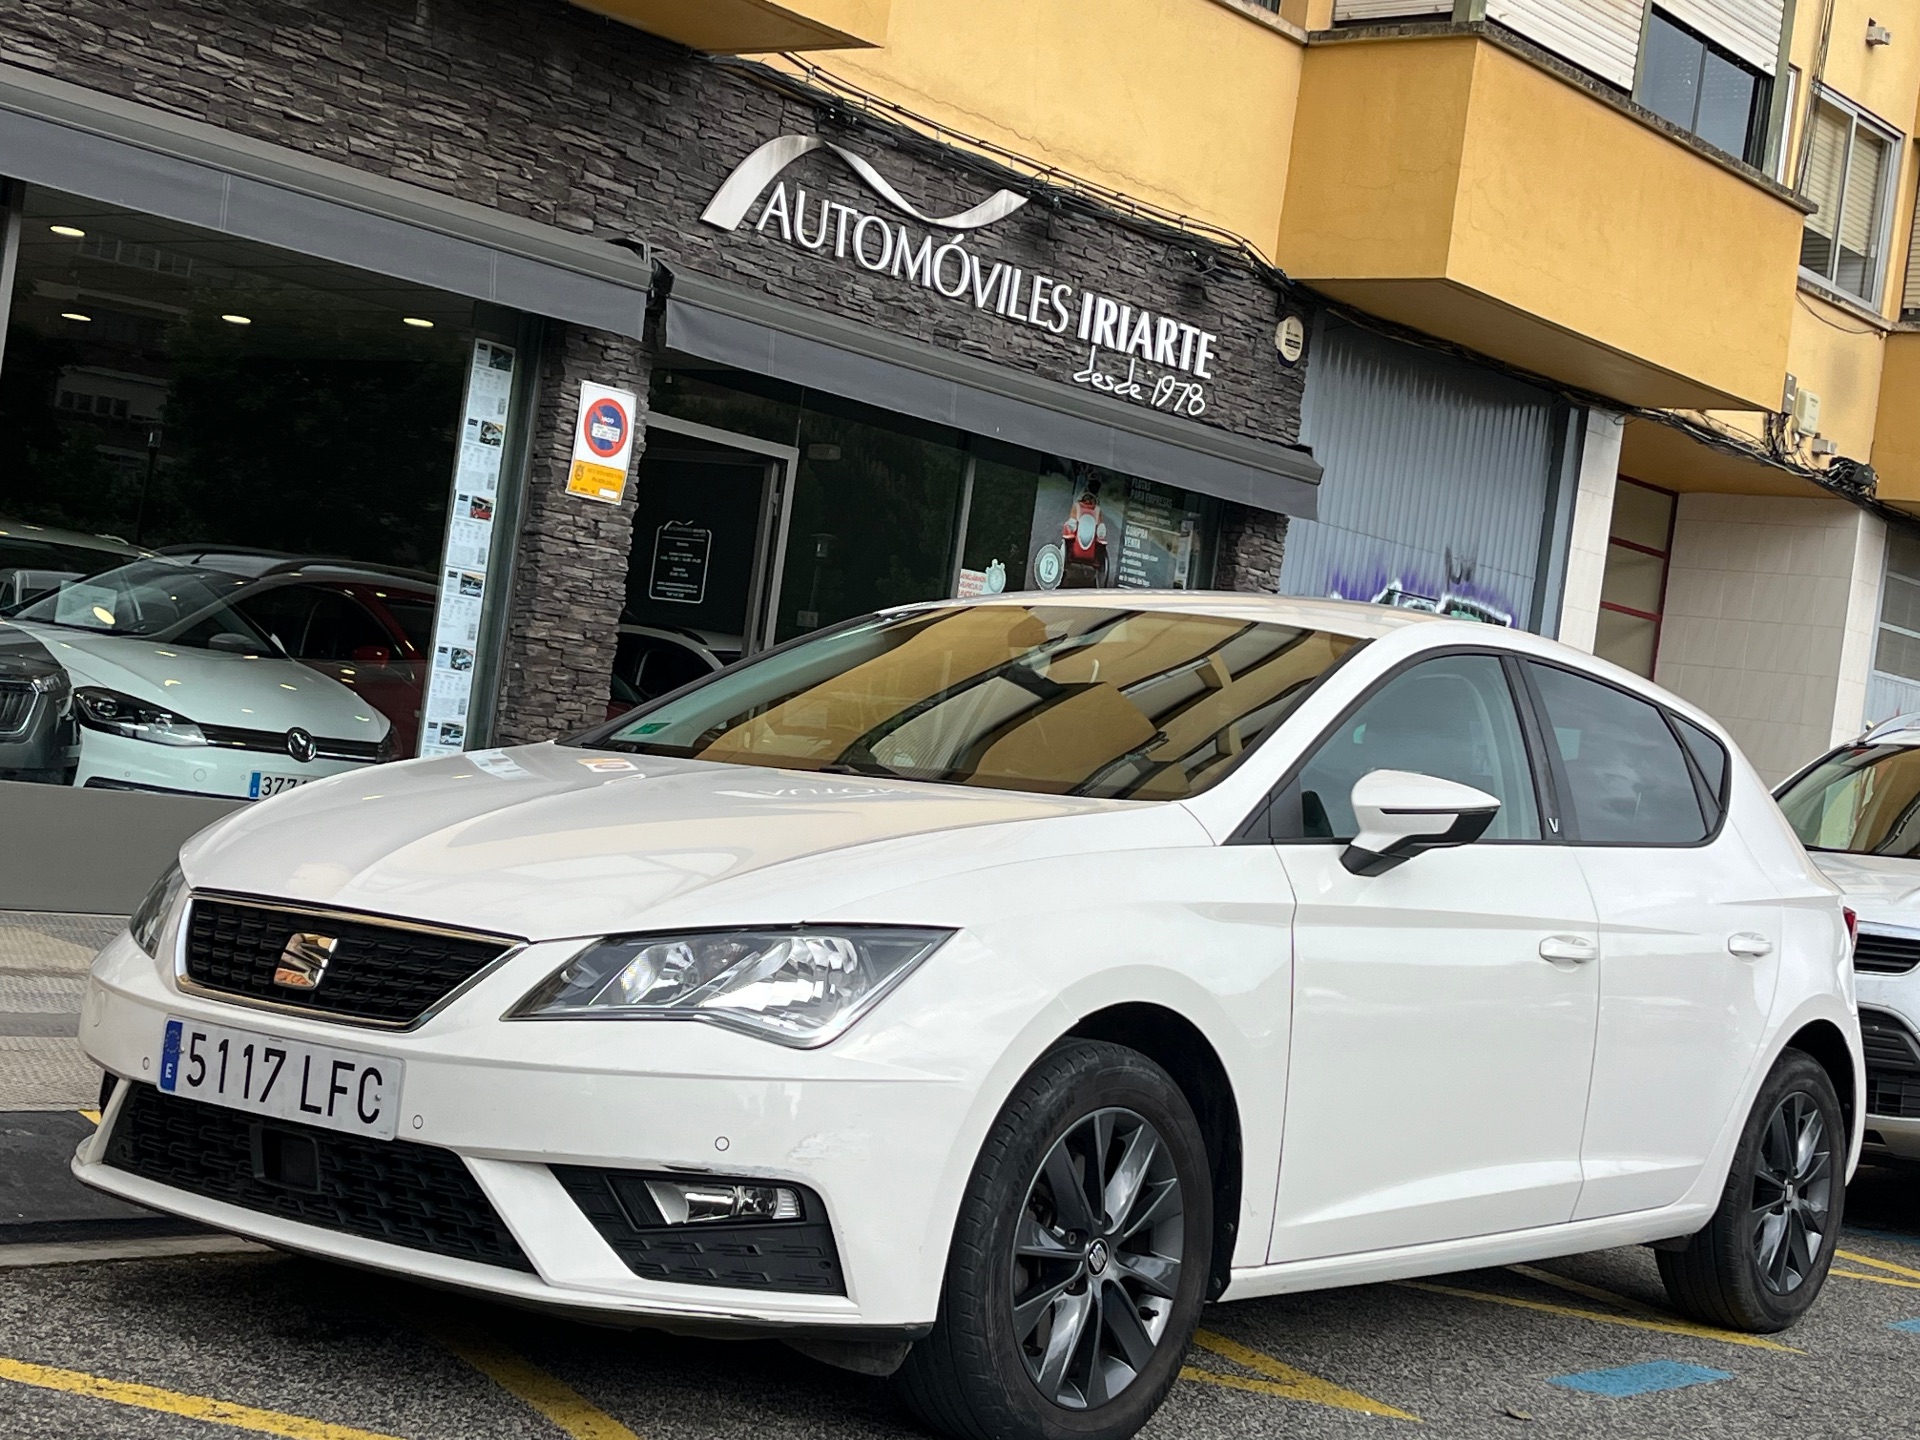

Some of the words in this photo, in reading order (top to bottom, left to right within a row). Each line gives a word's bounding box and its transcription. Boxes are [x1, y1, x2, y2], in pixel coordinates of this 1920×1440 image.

[755, 181, 1073, 333] AUTOMÓVILES
[1077, 292, 1217, 379] IRIARTE
[1072, 345, 1144, 399] desde
[1151, 375, 1207, 416] 1978
[1044, 559, 1054, 575] 12
[261, 776, 307, 796] 377
[164, 1062, 173, 1079] E
[186, 1032, 287, 1103] 5117
[300, 1055, 383, 1124] LFC
